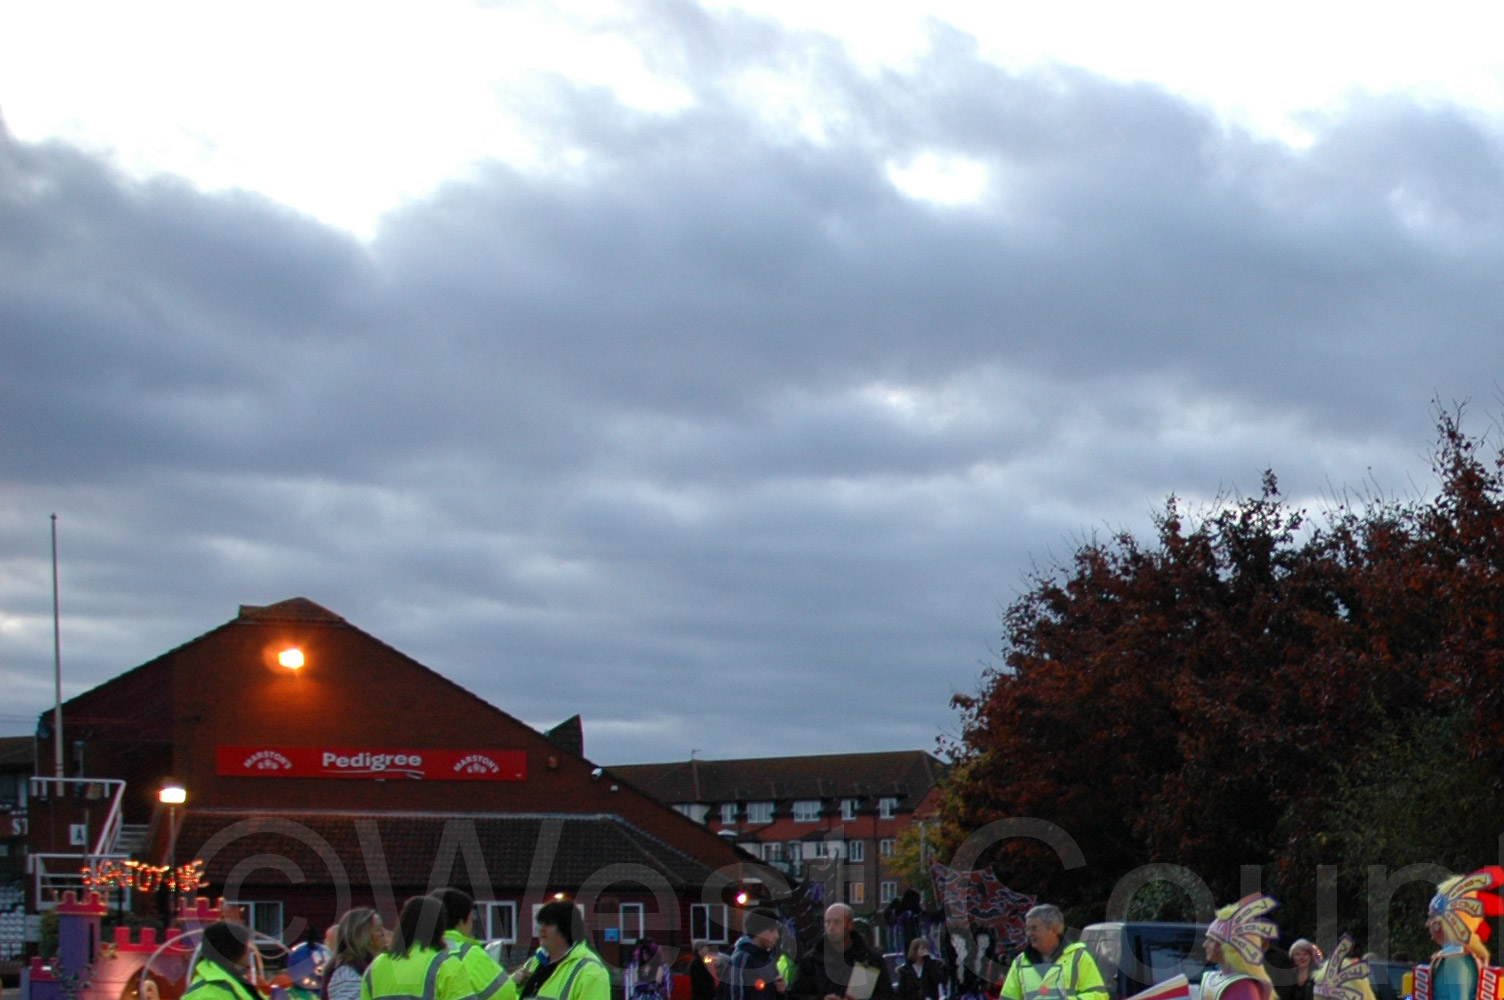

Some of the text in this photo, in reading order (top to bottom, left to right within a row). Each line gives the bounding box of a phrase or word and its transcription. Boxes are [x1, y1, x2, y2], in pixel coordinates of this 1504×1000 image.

[243, 750, 292, 769] MARSTON'S
[322, 751, 422, 771] Pedigree
[453, 754, 500, 774] MARSTON'S
